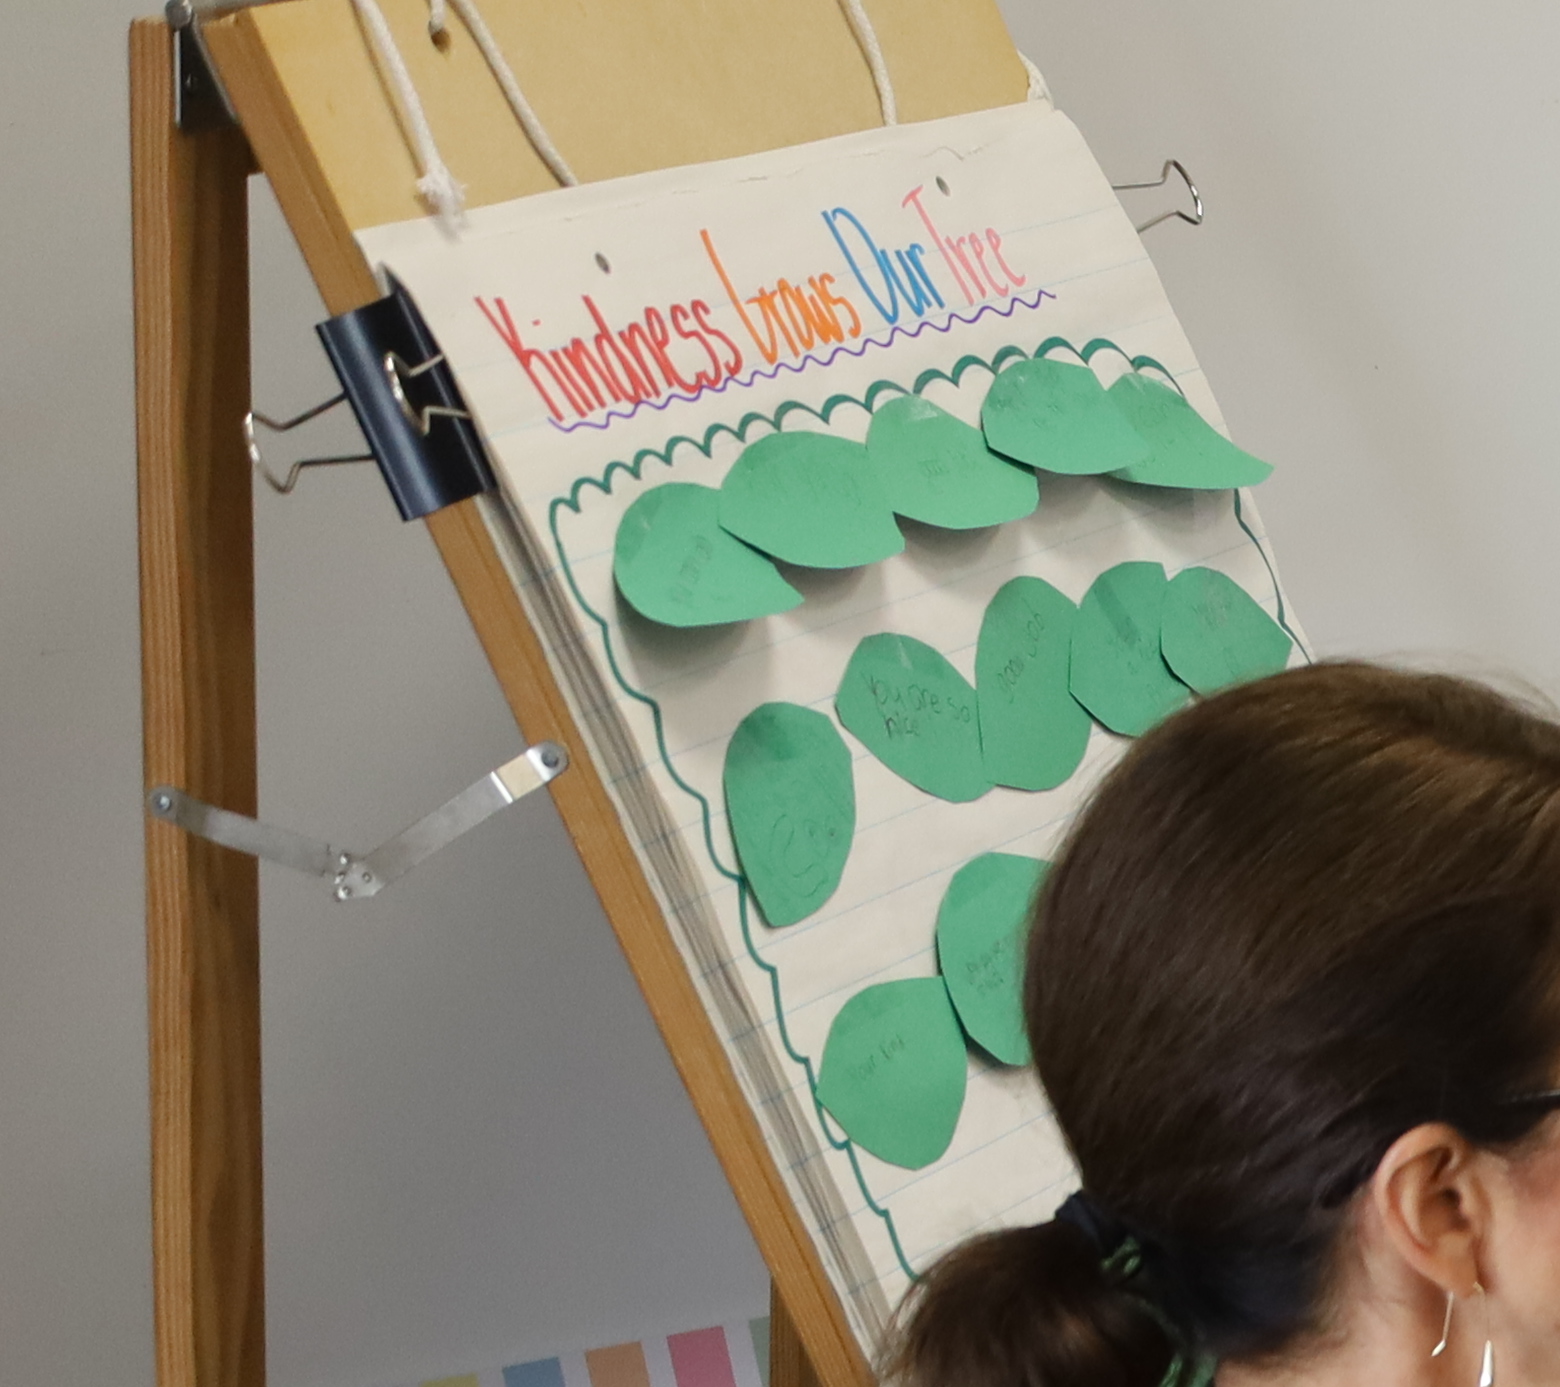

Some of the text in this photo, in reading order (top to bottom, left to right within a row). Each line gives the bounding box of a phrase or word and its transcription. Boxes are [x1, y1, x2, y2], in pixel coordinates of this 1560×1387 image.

[474, 185, 1027, 422] Kindness Grows Our Tree
